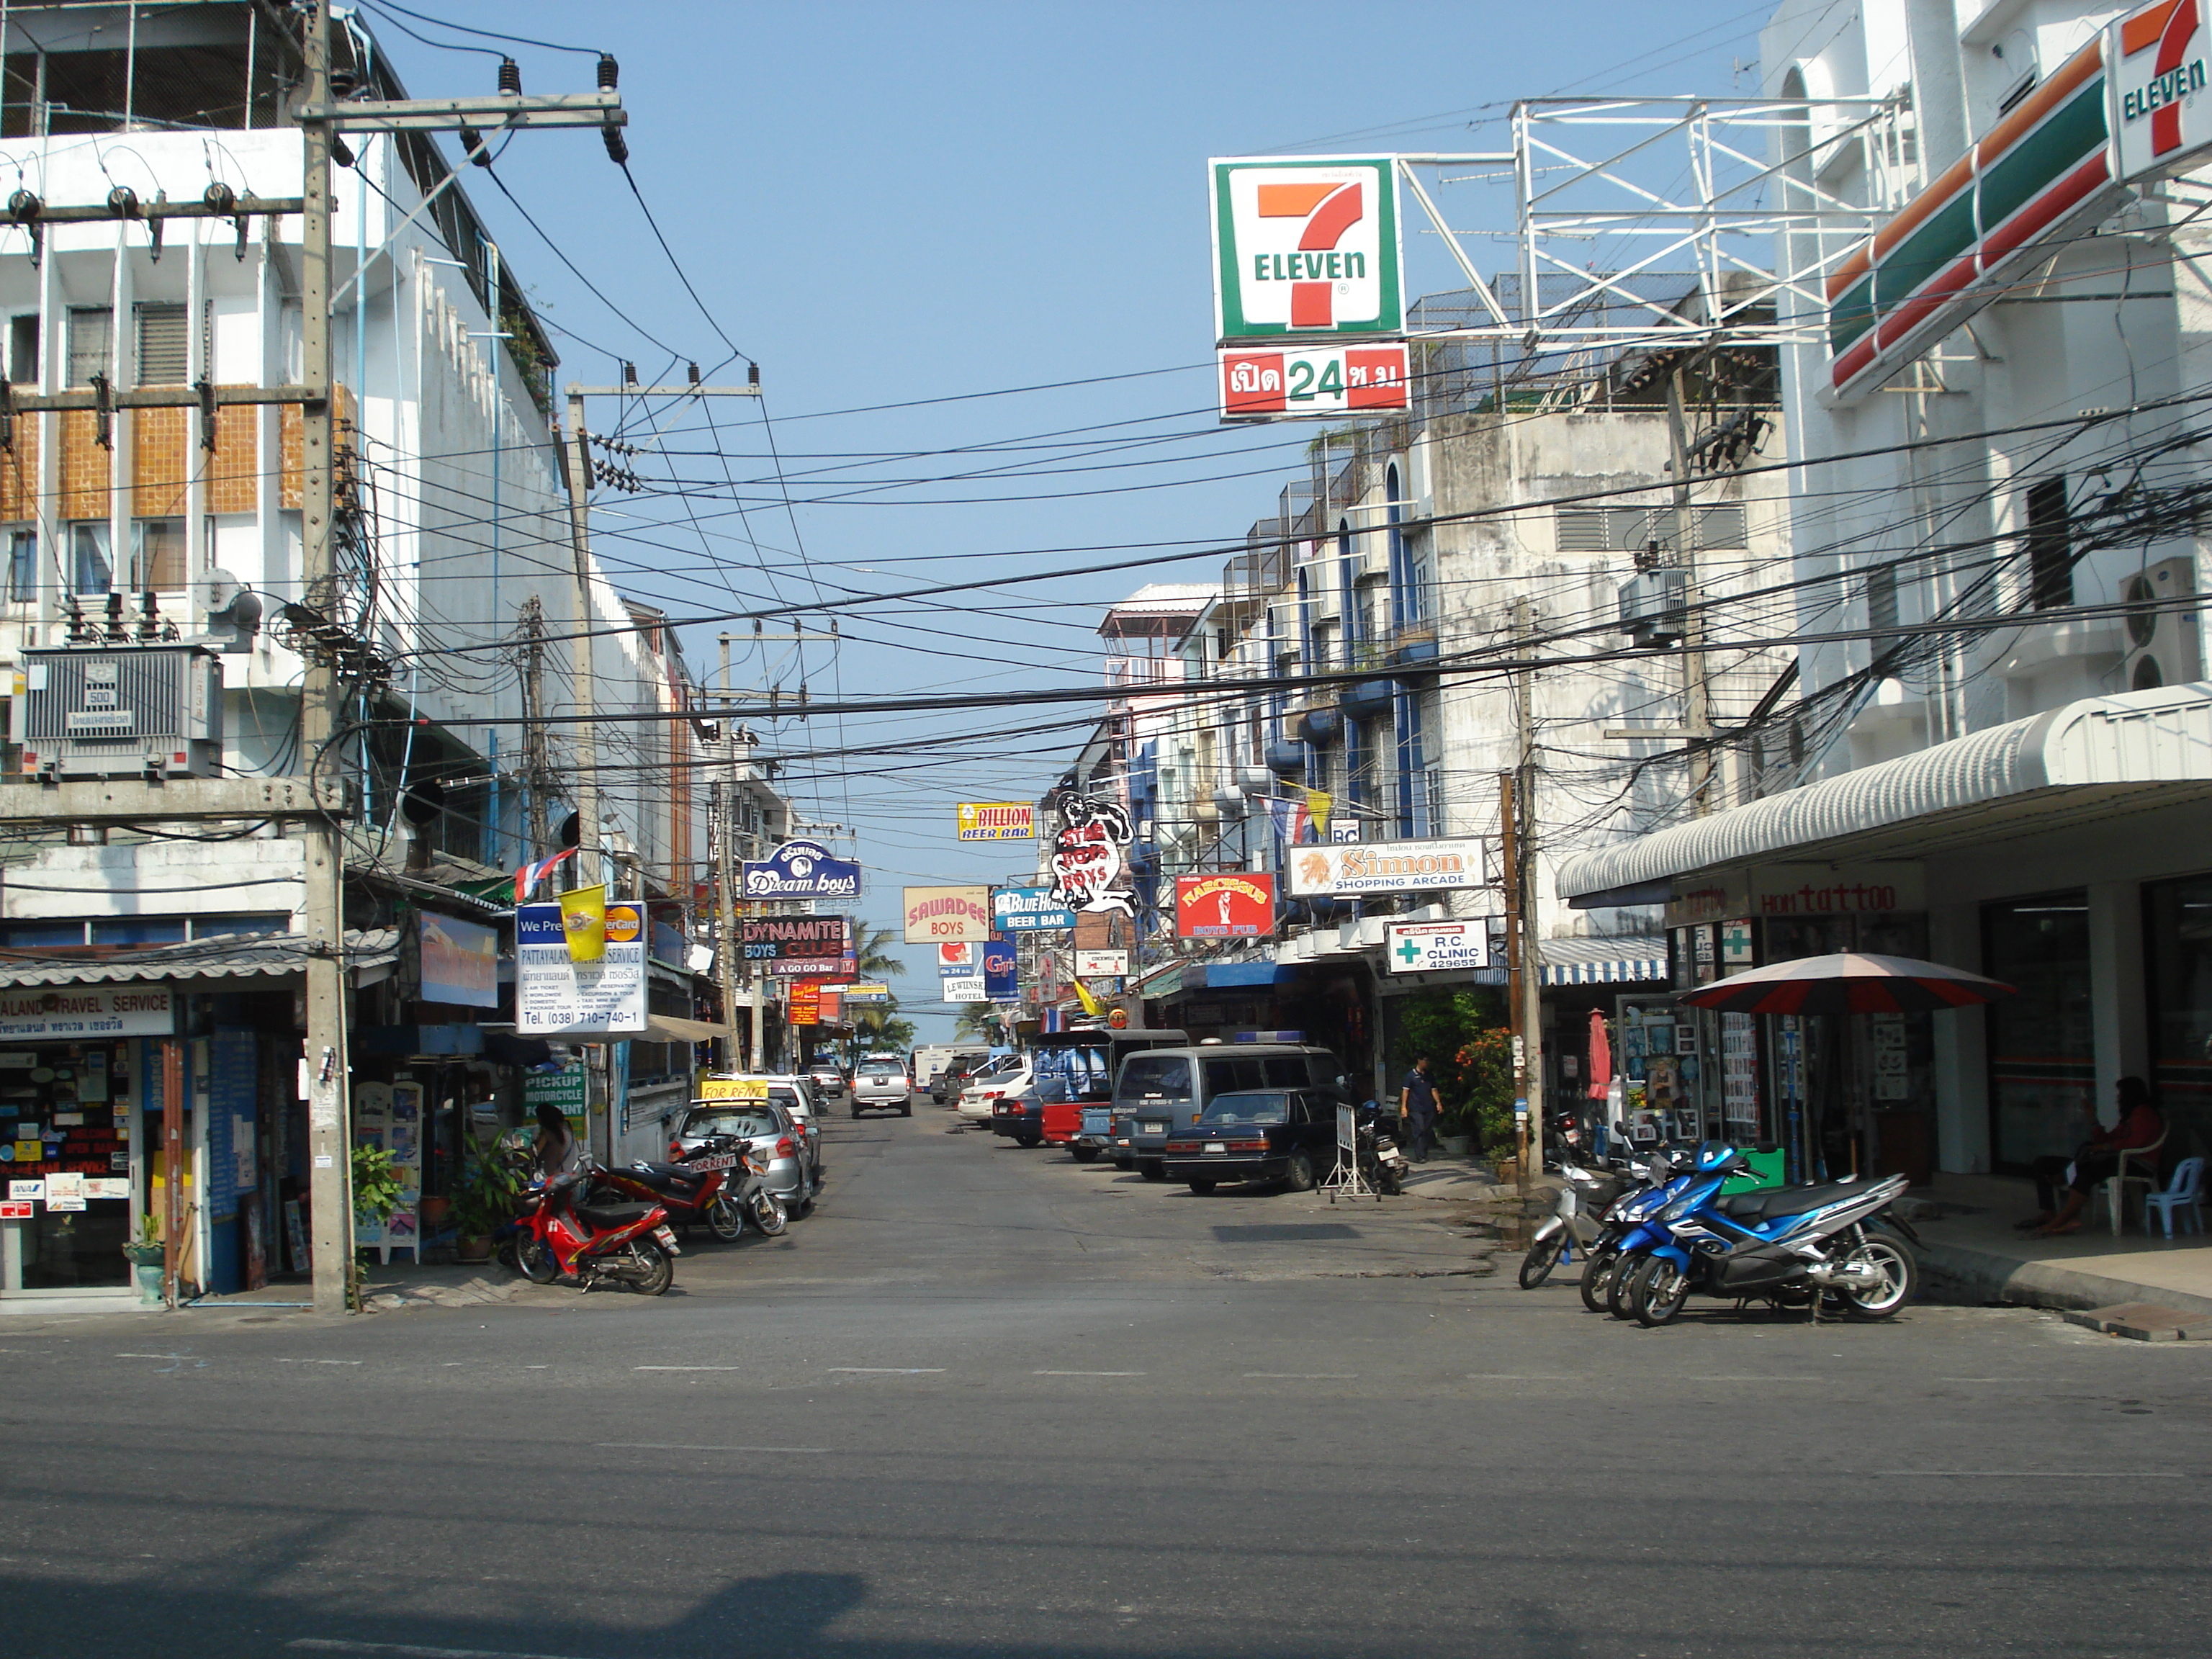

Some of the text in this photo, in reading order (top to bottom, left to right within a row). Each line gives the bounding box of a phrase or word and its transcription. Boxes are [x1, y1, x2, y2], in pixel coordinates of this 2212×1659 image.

[1231, 362, 1280, 392] เปิด
[1289, 359, 1344, 401] 24
[90, 692, 109, 703] 500
[979, 808, 1031, 827] BILLION
[963, 828, 1029, 839] BEER BAR
[1064, 823, 1106, 846] STAR
[1062, 845, 1107, 868] BOYS
[1341, 849, 1465, 879] Simon
[747, 873, 855, 895] Dream boys
[1062, 866, 1107, 889] BOYS
[1336, 874, 1465, 889] SHOPPING ARCADE
[1182, 878, 1268, 908] NARCISSUS
[1762, 883, 1896, 913] HOM tattoo
[909, 897, 986, 927] SAWADEE
[520, 921, 540, 932] We
[1007, 914, 1064, 927] BEER BAR
[743, 921, 841, 942] DYNAMITE
[931, 922, 963, 935] BOYS
[1192, 925, 1258, 935] BOYS PUB
[1435, 936, 1465, 947] R.C.
[608, 948, 639, 963] SERVICE
[745, 942, 842, 958] BOYS CLUB
[1427, 948, 1479, 958] CLINIC
[1429, 959, 1476, 968] 429655
[113, 994, 167, 1012] SERVICE
[525, 1011, 637, 1024] Tel. (038) 710-740-1
[525, 1076, 581, 1088] PICKUP
[526, 1089, 583, 1102] MOTORCYCLE
[704, 1087, 726, 1099] FOR
[691, 1159, 710, 1172] FOR
